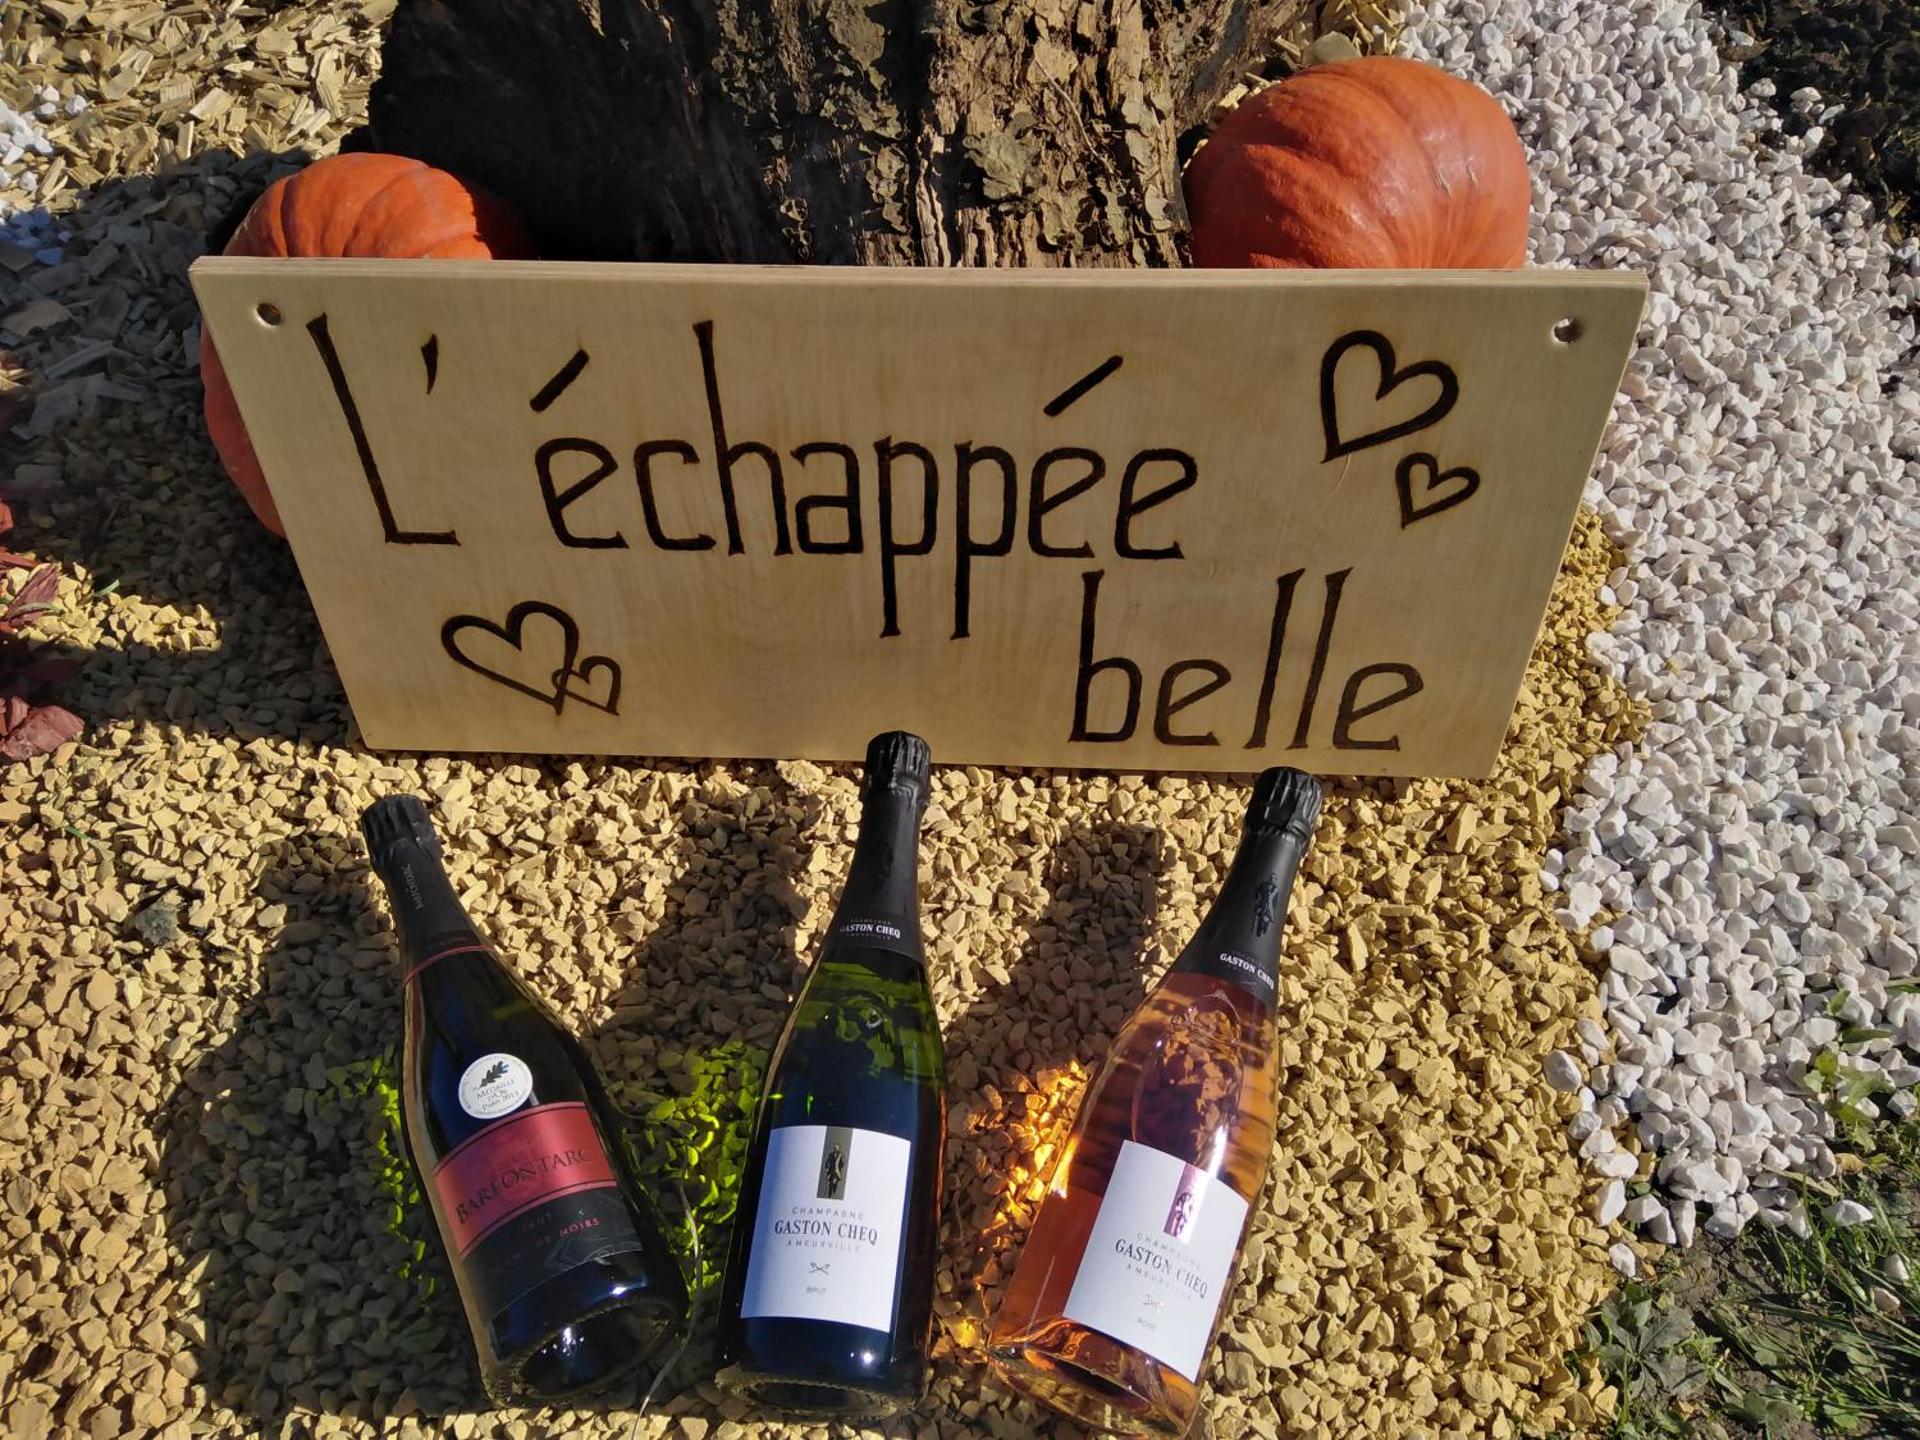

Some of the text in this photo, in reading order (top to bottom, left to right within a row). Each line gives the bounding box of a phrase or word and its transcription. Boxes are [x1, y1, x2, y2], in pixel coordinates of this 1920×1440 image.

[306, 312, 1198, 640] L'échappée
[1068, 567, 1425, 751] belle
[876, 925, 901, 938] CHEQ
[1220, 953, 1256, 973] GASTON
[455, 1149, 595, 1225] BARFONTARC
[792, 1206, 864, 1219] CHAMPAGNE
[559, 1216, 602, 1239] NOIRS
[774, 1218, 879, 1246] GASTON CHEQ
[1115, 1239, 1208, 1299] GASTON CHEQ
